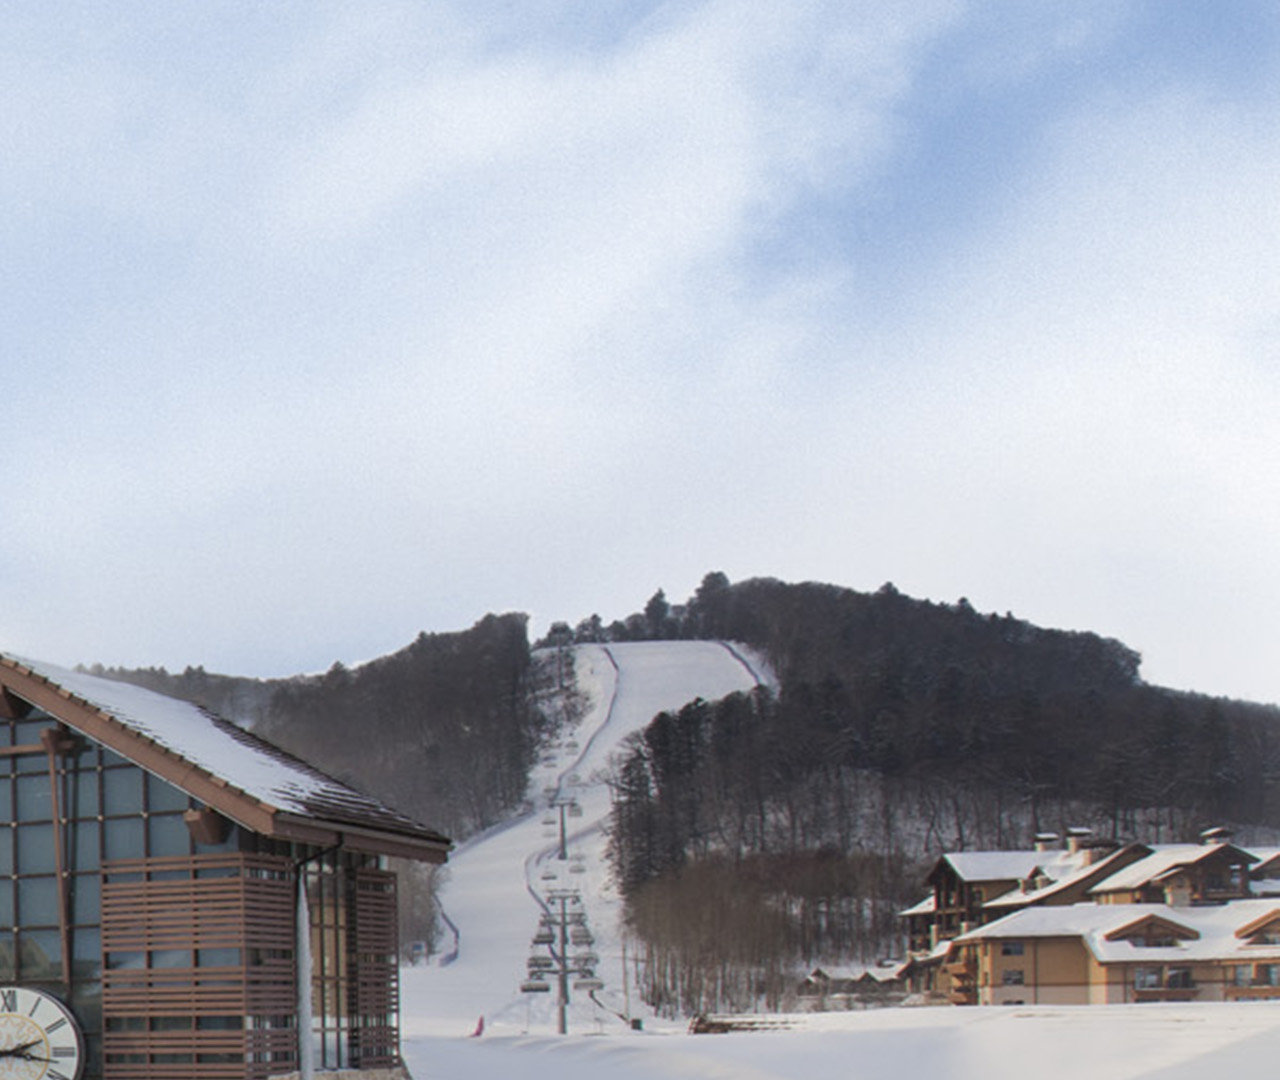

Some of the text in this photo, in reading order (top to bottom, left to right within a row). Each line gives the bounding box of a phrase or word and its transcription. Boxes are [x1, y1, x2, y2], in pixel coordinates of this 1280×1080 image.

[0, 990, 17, 1012] XII
[45, 1018, 67, 1034] II
[52, 1046, 75, 1057] III
